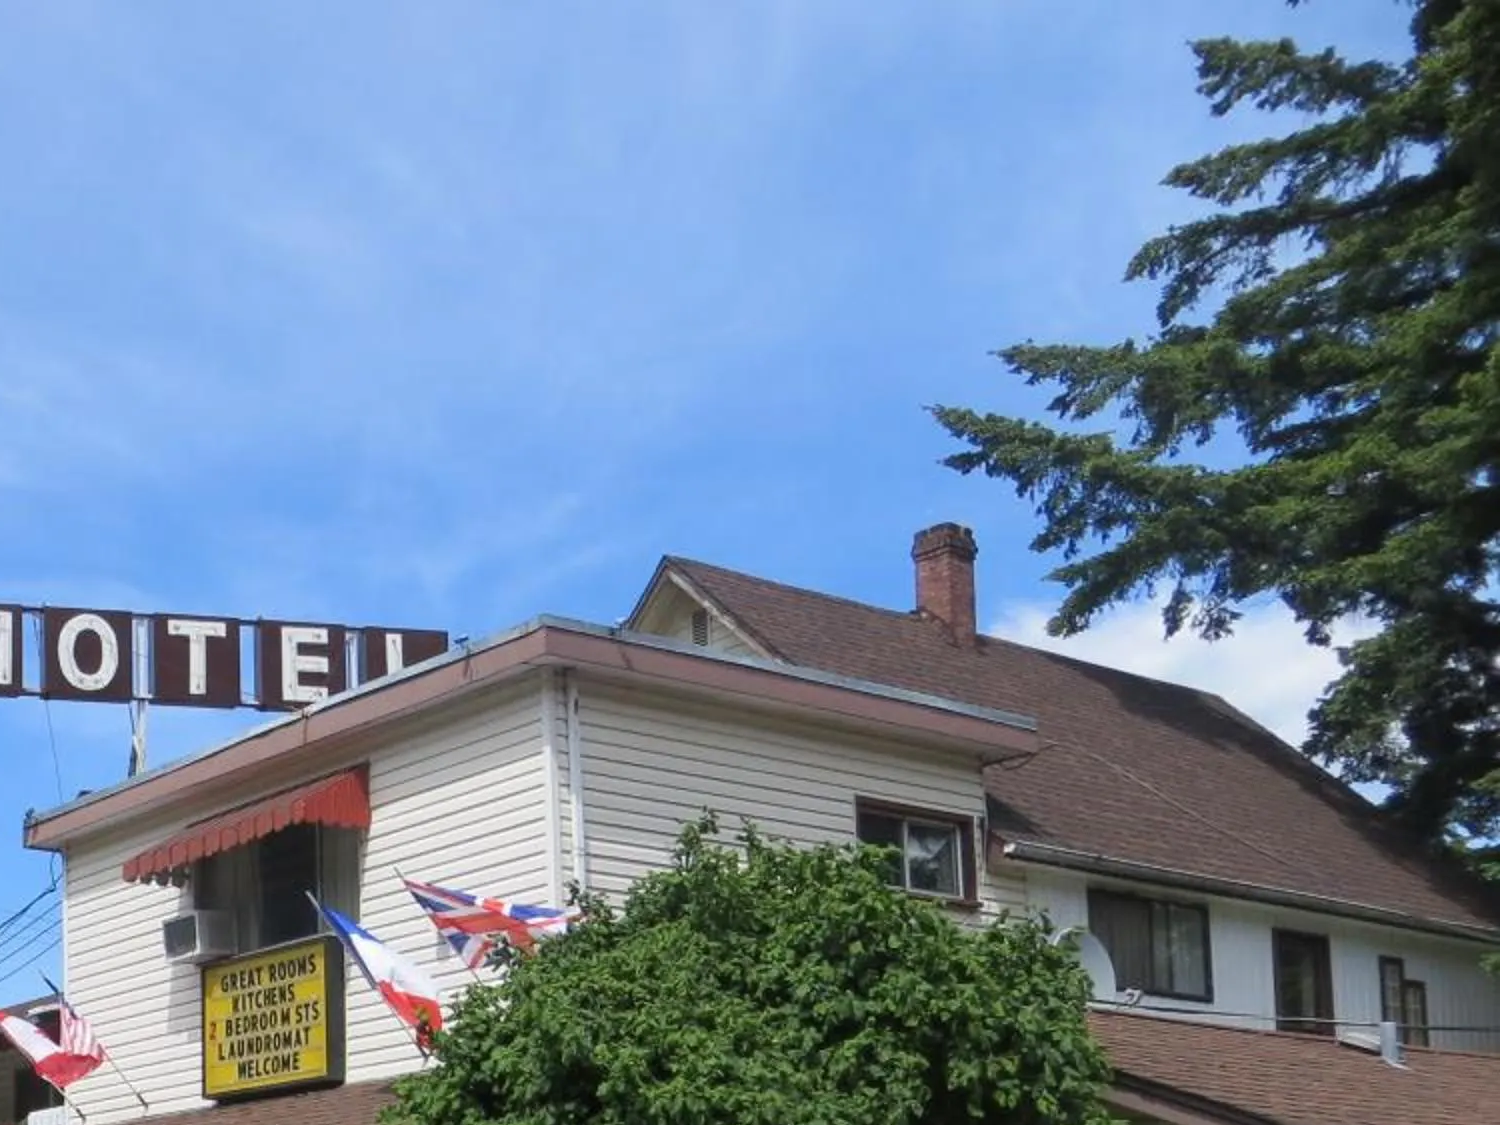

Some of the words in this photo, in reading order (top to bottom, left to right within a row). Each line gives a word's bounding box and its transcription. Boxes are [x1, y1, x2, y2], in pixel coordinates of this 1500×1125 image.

[220, 967, 266, 993] GREAT
[269, 954, 317, 983] ROOMS
[232, 984, 296, 1012] KITCHENS
[209, 1021, 217, 1040] 2
[225, 1007, 291, 1036] BEDROOM
[295, 1001, 320, 1024] STS
[218, 1027, 312, 1060] LAUNDROMAT
[237, 1052, 299, 1079] WELCOME
